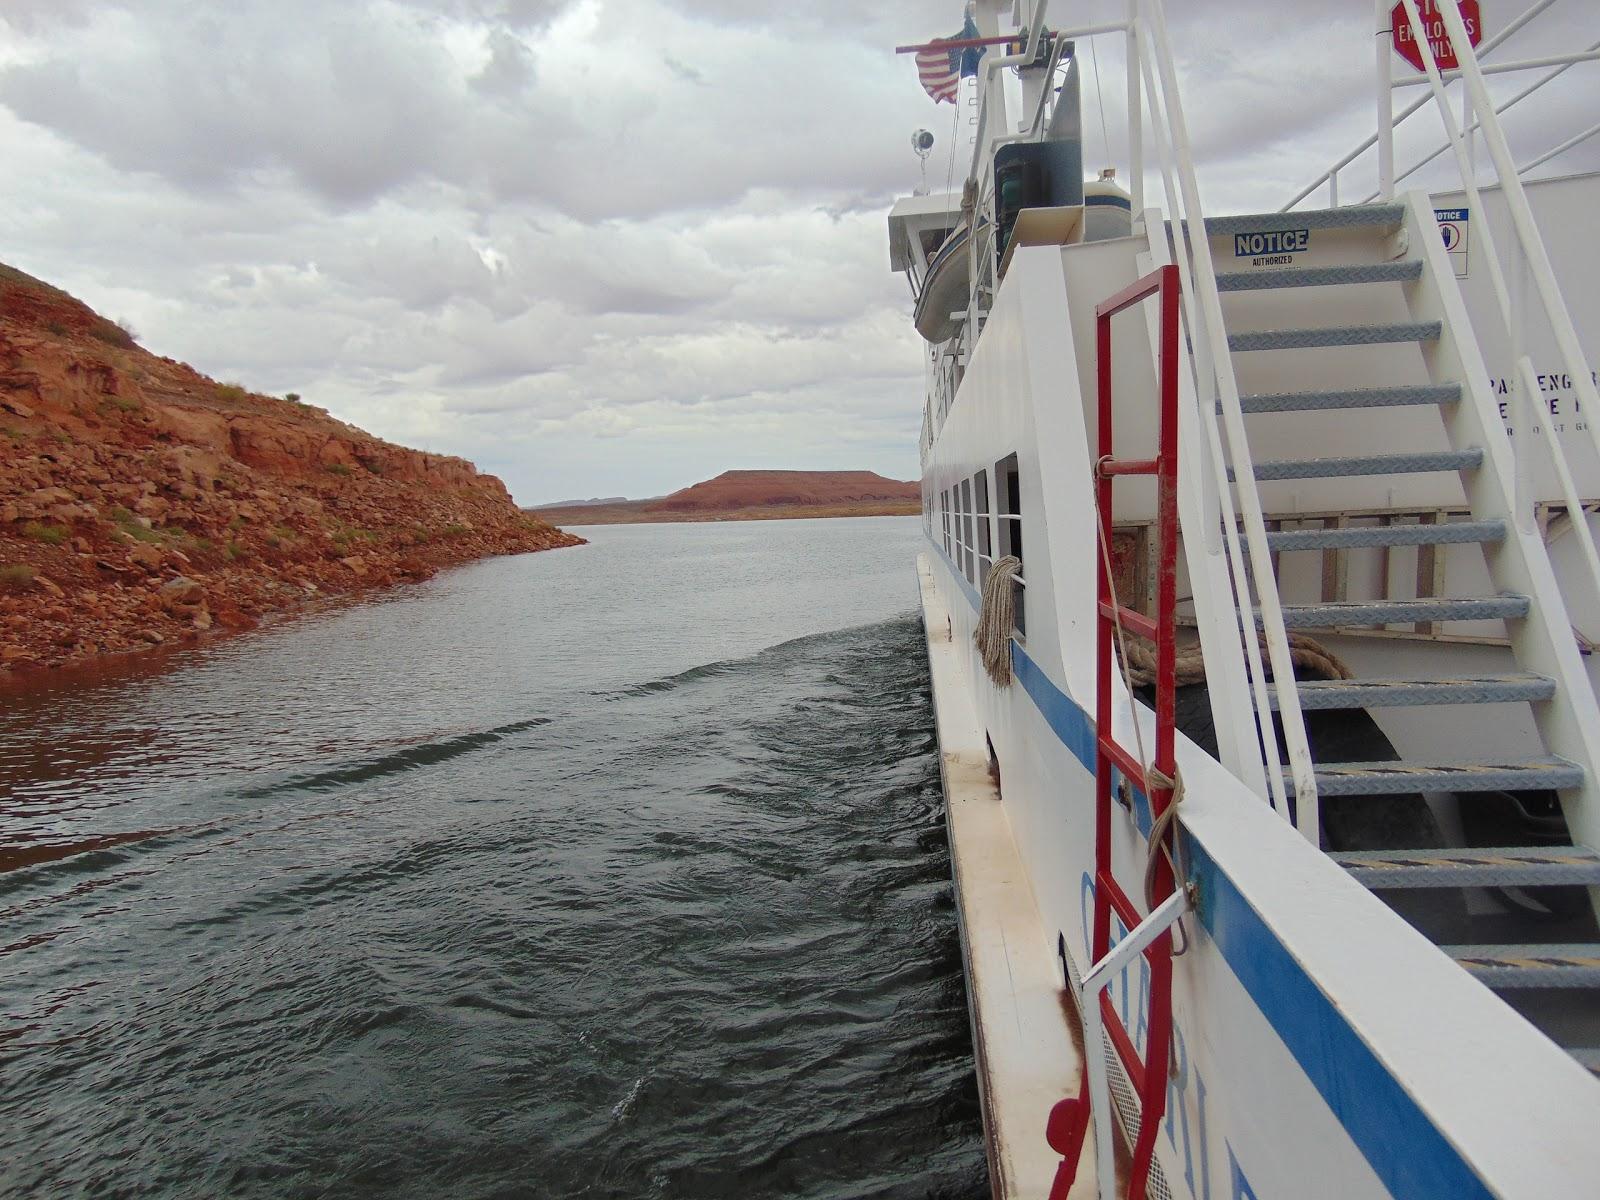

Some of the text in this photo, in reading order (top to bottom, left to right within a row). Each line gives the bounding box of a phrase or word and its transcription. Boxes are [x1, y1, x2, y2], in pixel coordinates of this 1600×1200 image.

[1430, 40, 1456, 59] NLY
[1435, 211, 1461, 221] OTICE
[1237, 230, 1307, 254] NOTICE
[1252, 255, 1293, 267] AUTHORIZED
